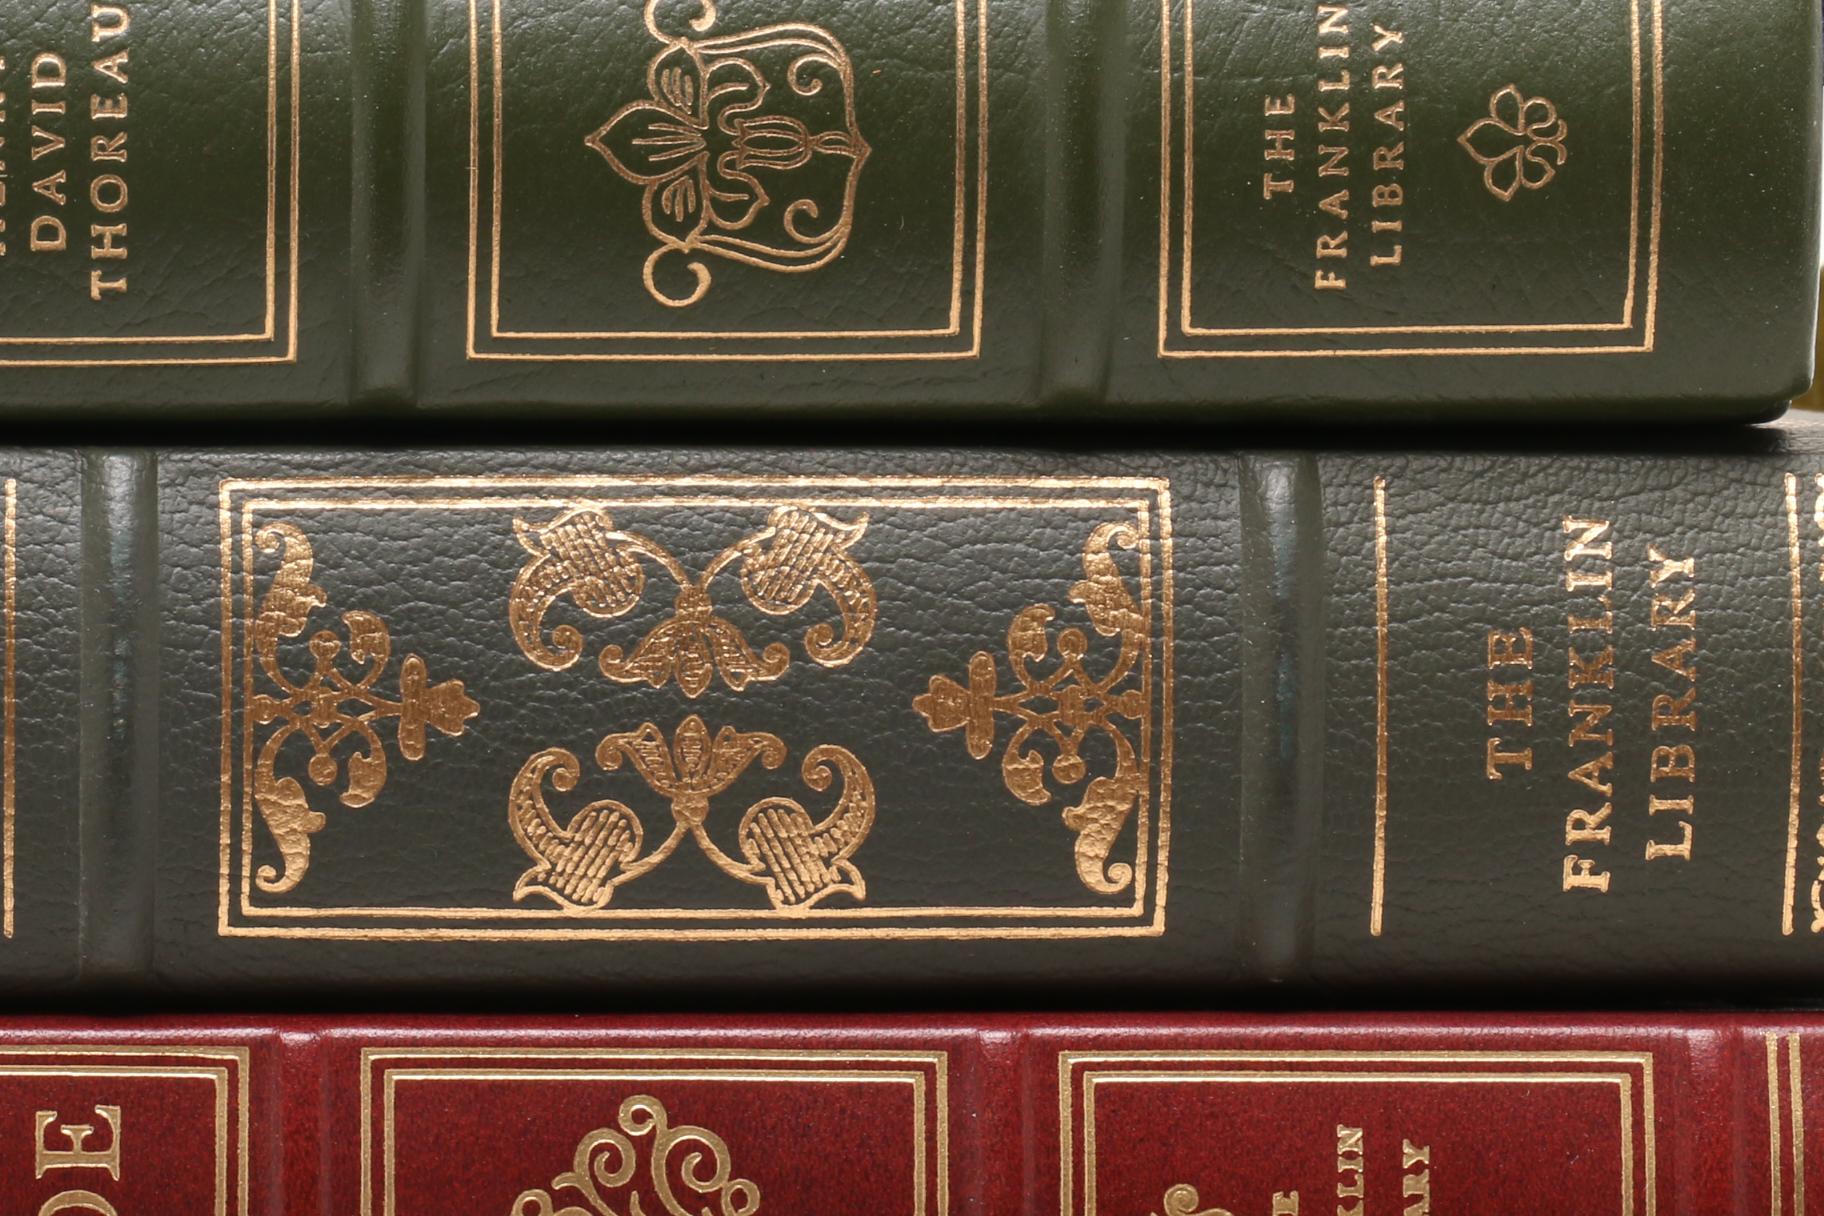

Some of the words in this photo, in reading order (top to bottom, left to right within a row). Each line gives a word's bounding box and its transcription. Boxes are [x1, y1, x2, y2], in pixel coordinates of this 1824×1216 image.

[30, 51, 68, 252] DAVID
[90, 3, 129, 301] THOREAU
[1264, 93, 1297, 200] THE
[1314, 4, 1351, 292] FRANKLIN
[1370, 22, 1406, 268] LIBRARY
[1486, 626, 1534, 781] THE
[1562, 514, 1615, 893] FRANKLIN
[1645, 543, 1697, 862] LIBRARY
